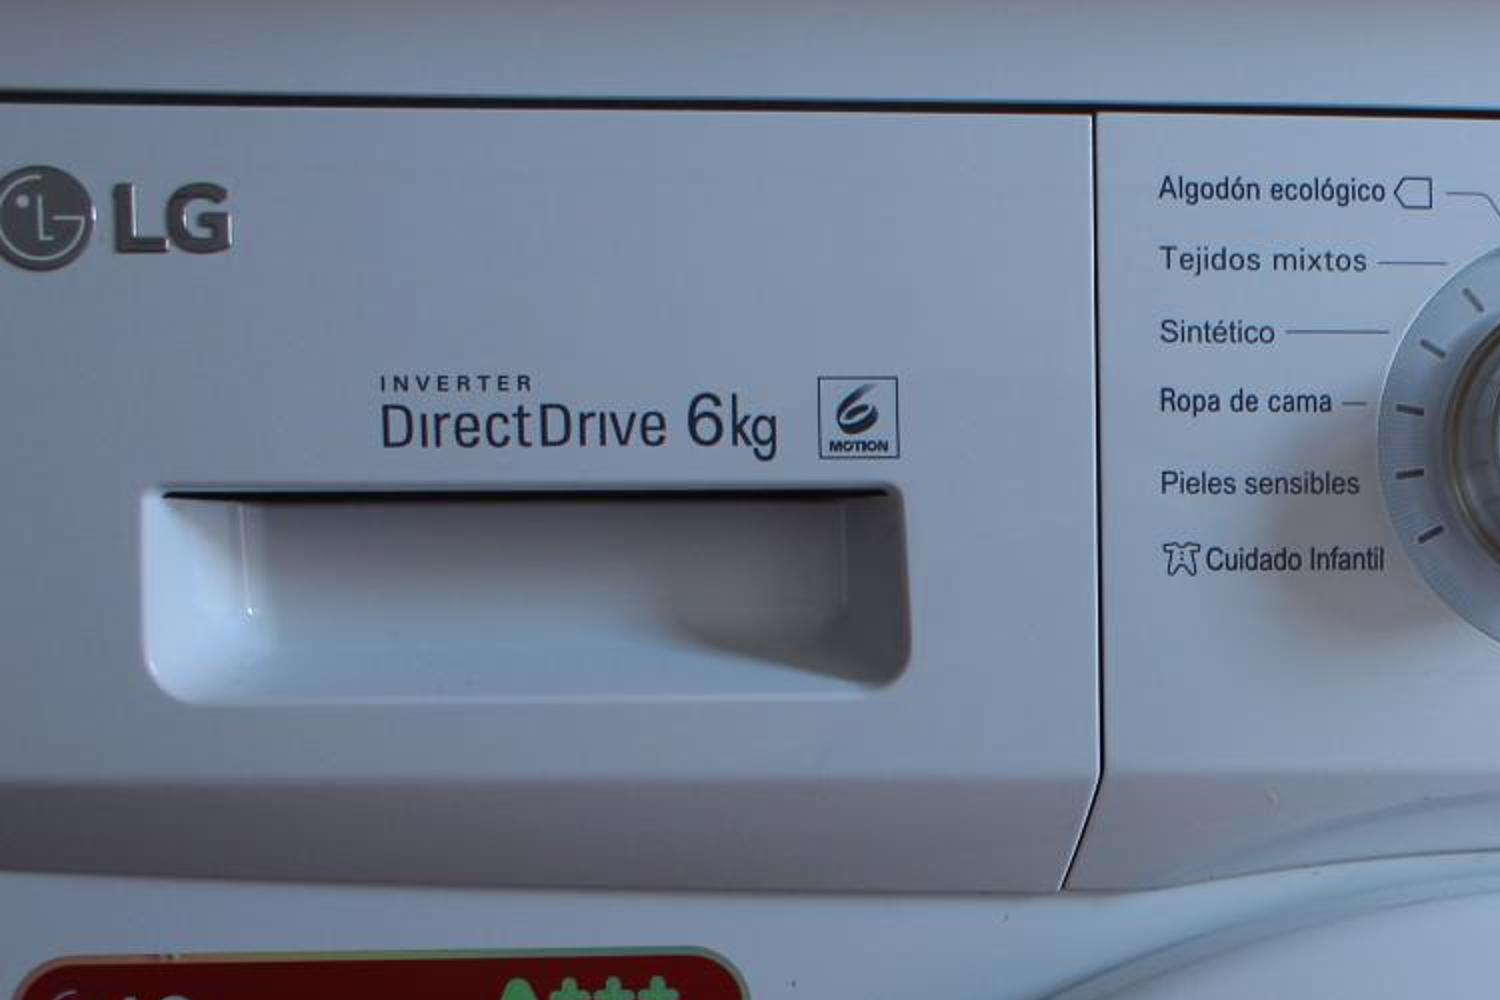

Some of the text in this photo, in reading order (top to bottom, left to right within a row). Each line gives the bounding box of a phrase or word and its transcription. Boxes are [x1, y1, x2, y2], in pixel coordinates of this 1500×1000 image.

[1159, 176, 1385, 207] Algodón ecológico
[112, 182, 230, 254] LG
[1160, 246, 1366, 276] Tejidos mixtos
[1160, 319, 1274, 344] Sintético
[381, 375, 530, 392] INVERTER
[1161, 388, 1332, 417] Ropa de cama
[829, 440, 888, 452] MOTION
[1162, 470, 1360, 495] Pieles sensibles
[1206, 546, 1384, 571] Cuidado Infantil
